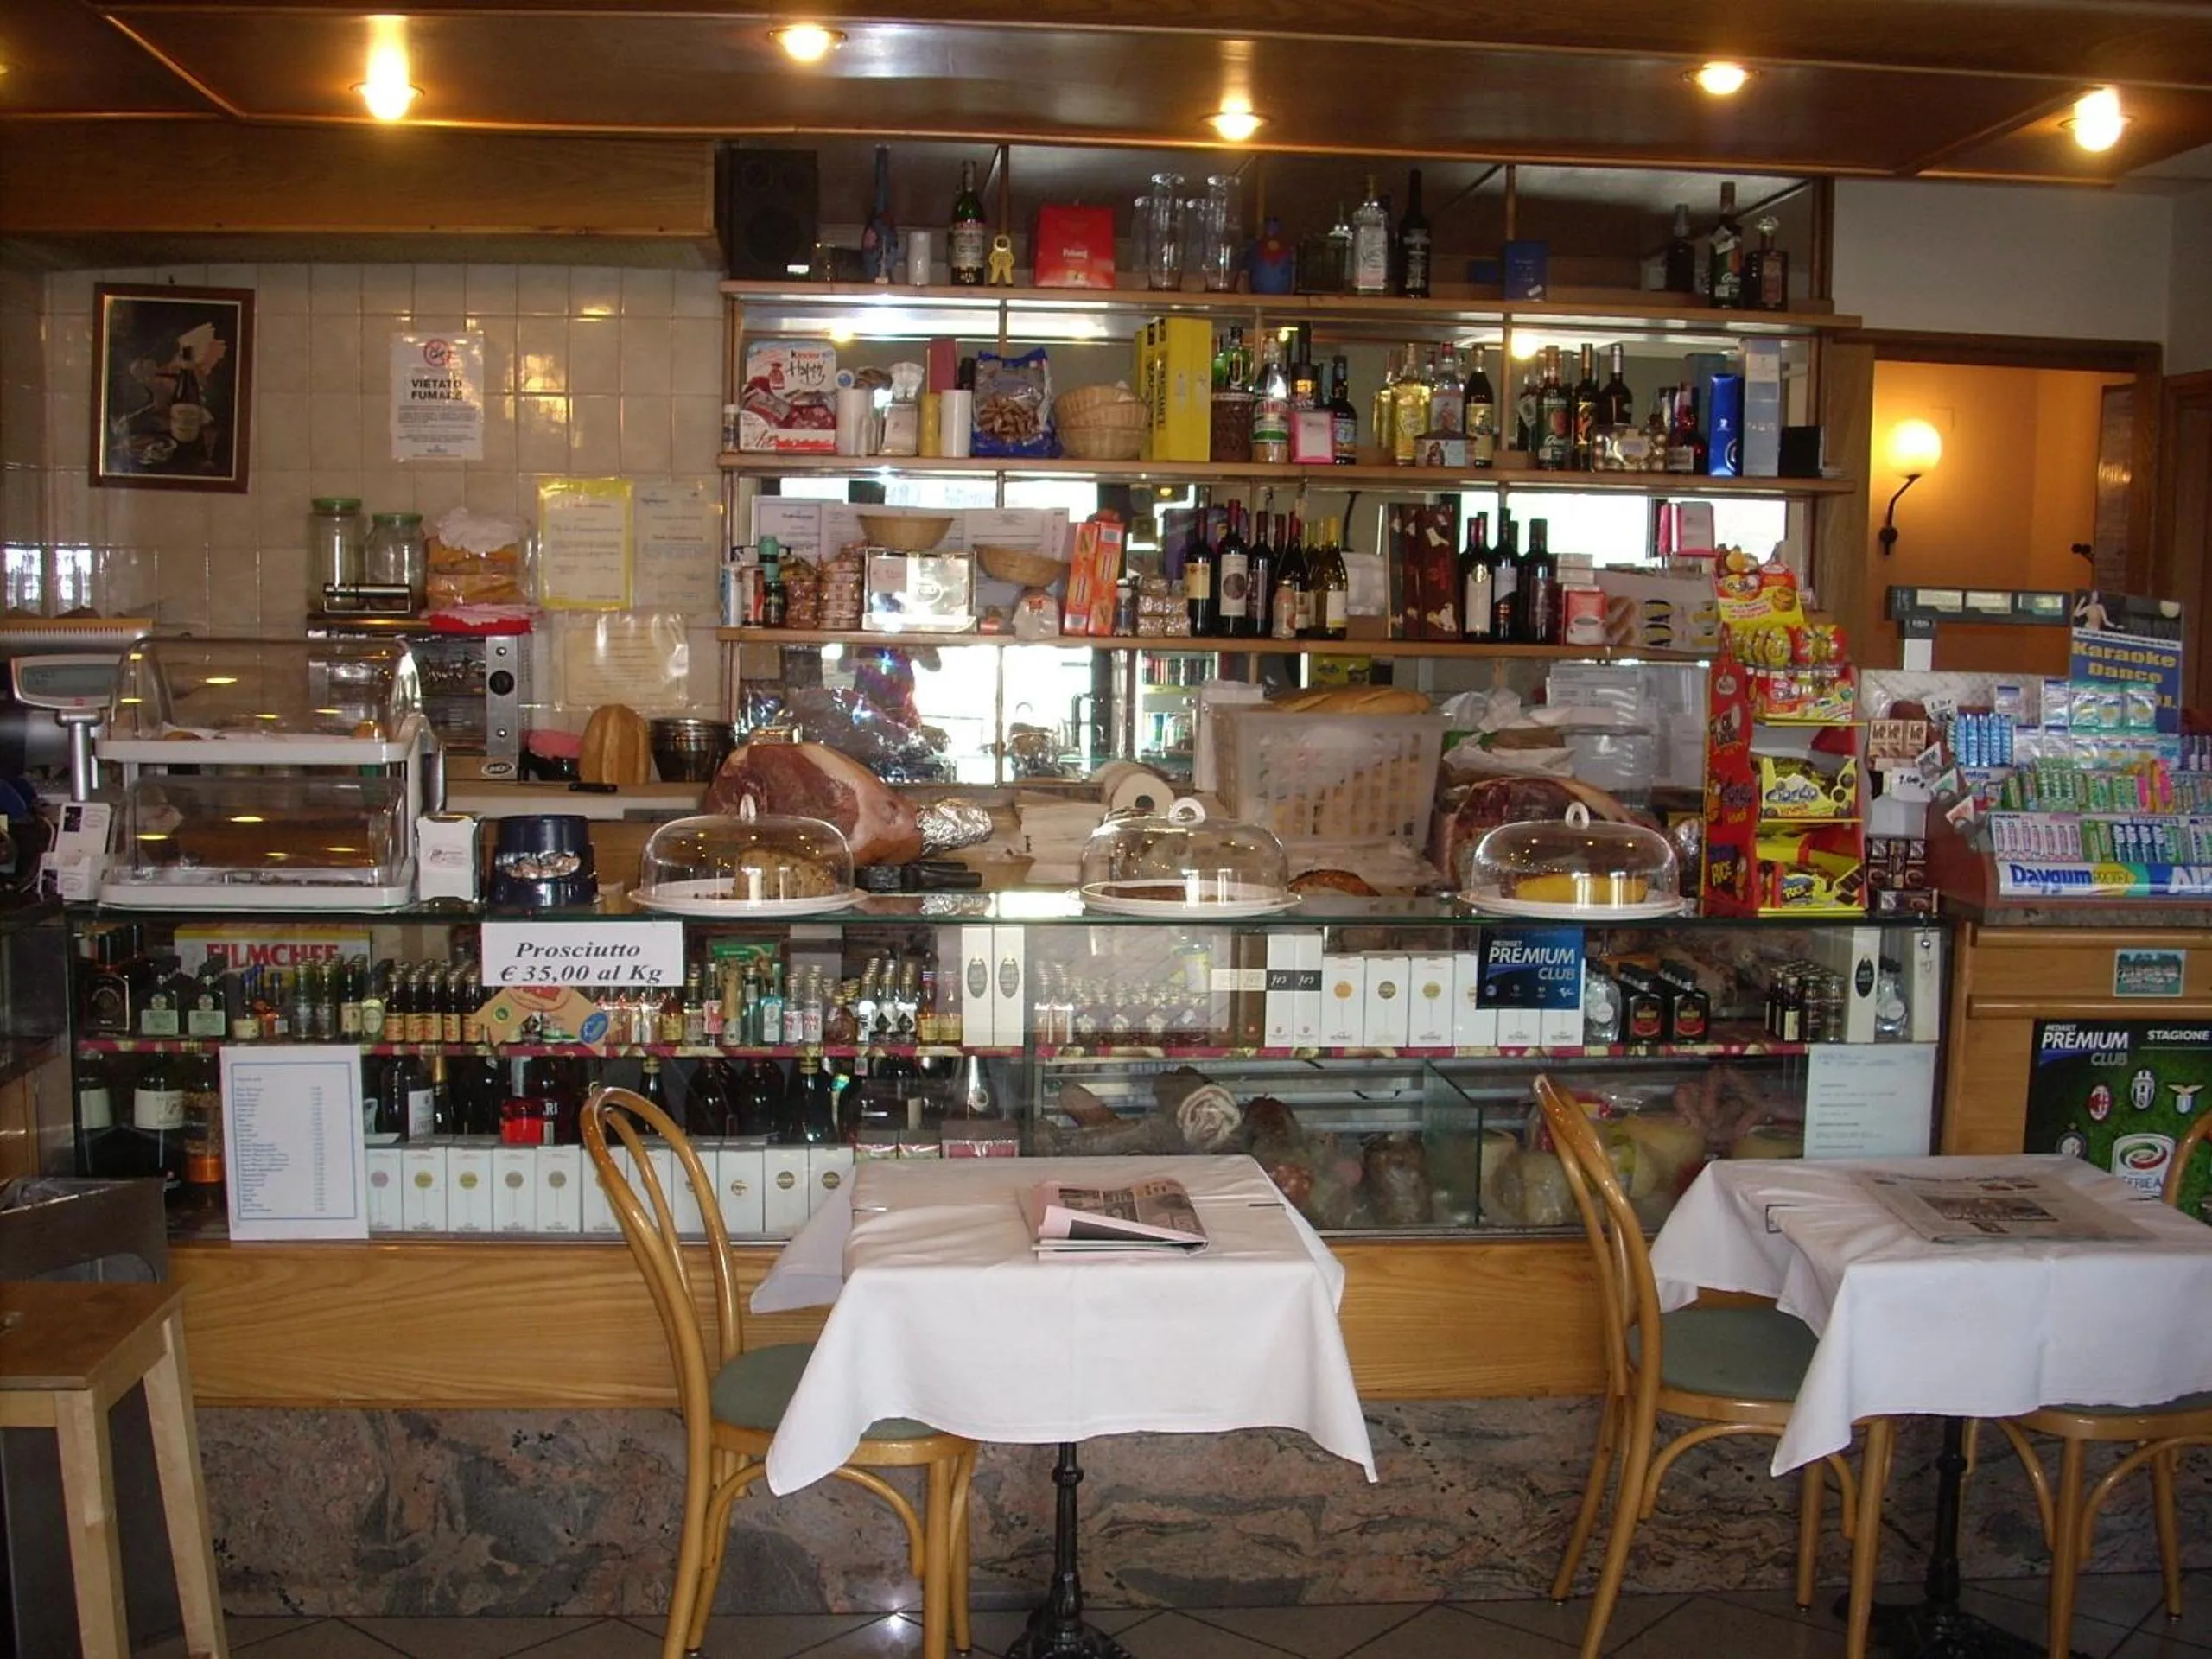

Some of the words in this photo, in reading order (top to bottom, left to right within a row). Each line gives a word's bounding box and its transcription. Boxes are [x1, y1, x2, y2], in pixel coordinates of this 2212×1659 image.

[411, 378, 462, 389] VIETATO
[2072, 641, 2177, 668] Karaoke
[2010, 864, 2093, 893] Daygum
[207, 944, 339, 969] FILMCHEF
[515, 941, 641, 958] Prosciutto
[1488, 946, 1575, 965] PREMIUM
[501, 966, 518, 982] €
[522, 964, 590, 982] 35,00
[597, 964, 621, 981] al
[629, 965, 664, 984] Kg
[1538, 967, 1574, 980] CLUB
[2041, 1031, 2129, 1049] PREMIUM
[2147, 1030, 2209, 1041] STAGIONE
[2090, 1052, 2128, 1066] CLUB
